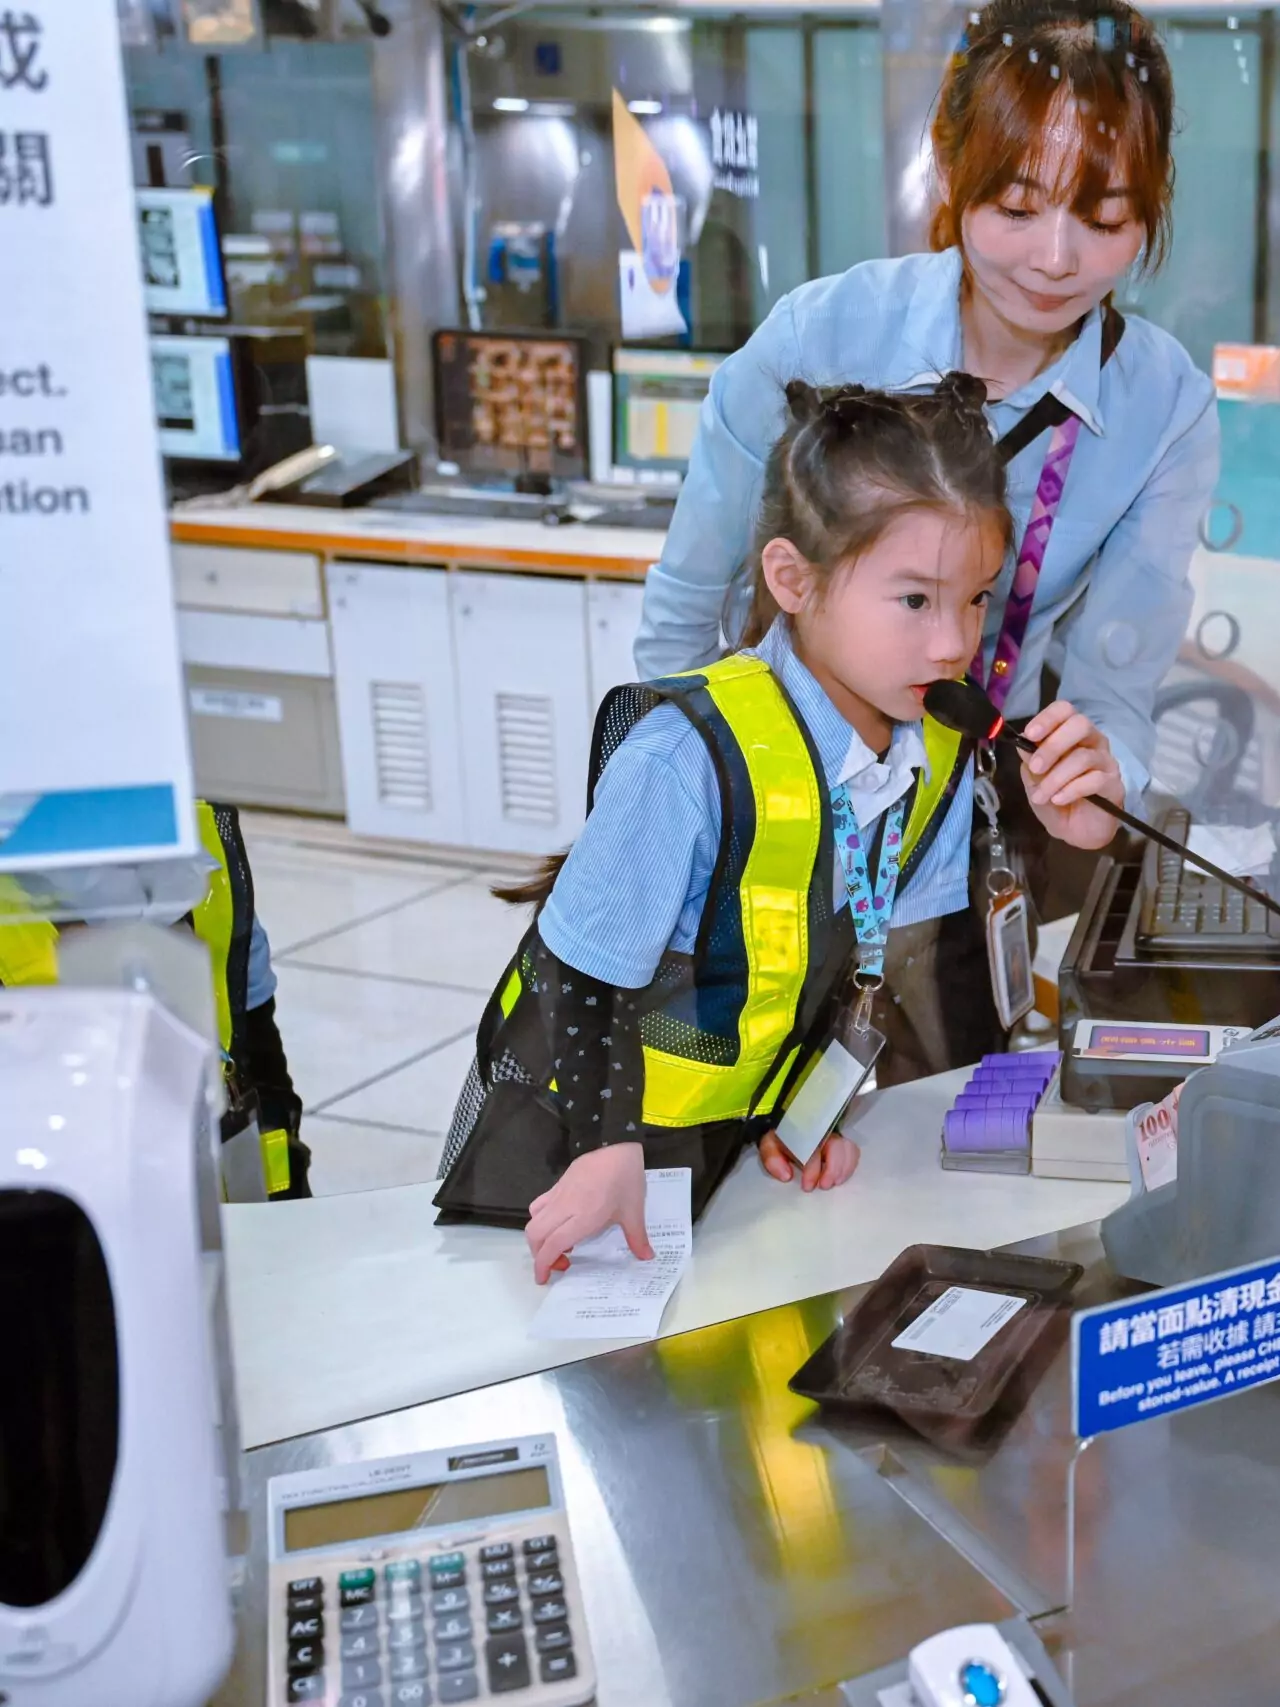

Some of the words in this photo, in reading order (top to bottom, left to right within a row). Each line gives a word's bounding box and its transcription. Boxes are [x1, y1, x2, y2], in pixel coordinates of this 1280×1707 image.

[0, 427, 63, 455] an
[1139, 1108, 1171, 1142] 100
[1157, 1319, 1250, 1369] 若需收據
[1098, 1382, 1146, 1406] Before
[1147, 1374, 1172, 1395] you
[1174, 1362, 1213, 1383] leave,
[1214, 1348, 1256, 1373] please
[1138, 1376, 1222, 1413] stored-value.
[1224, 1369, 1236, 1385] A
[1236, 1355, 1280, 1381] receipt
[290, 1618, 319, 1636] AC
[351, 1609, 364, 1623] 7
[297, 1646, 313, 1663] C
[352, 1636, 366, 1650] 4
